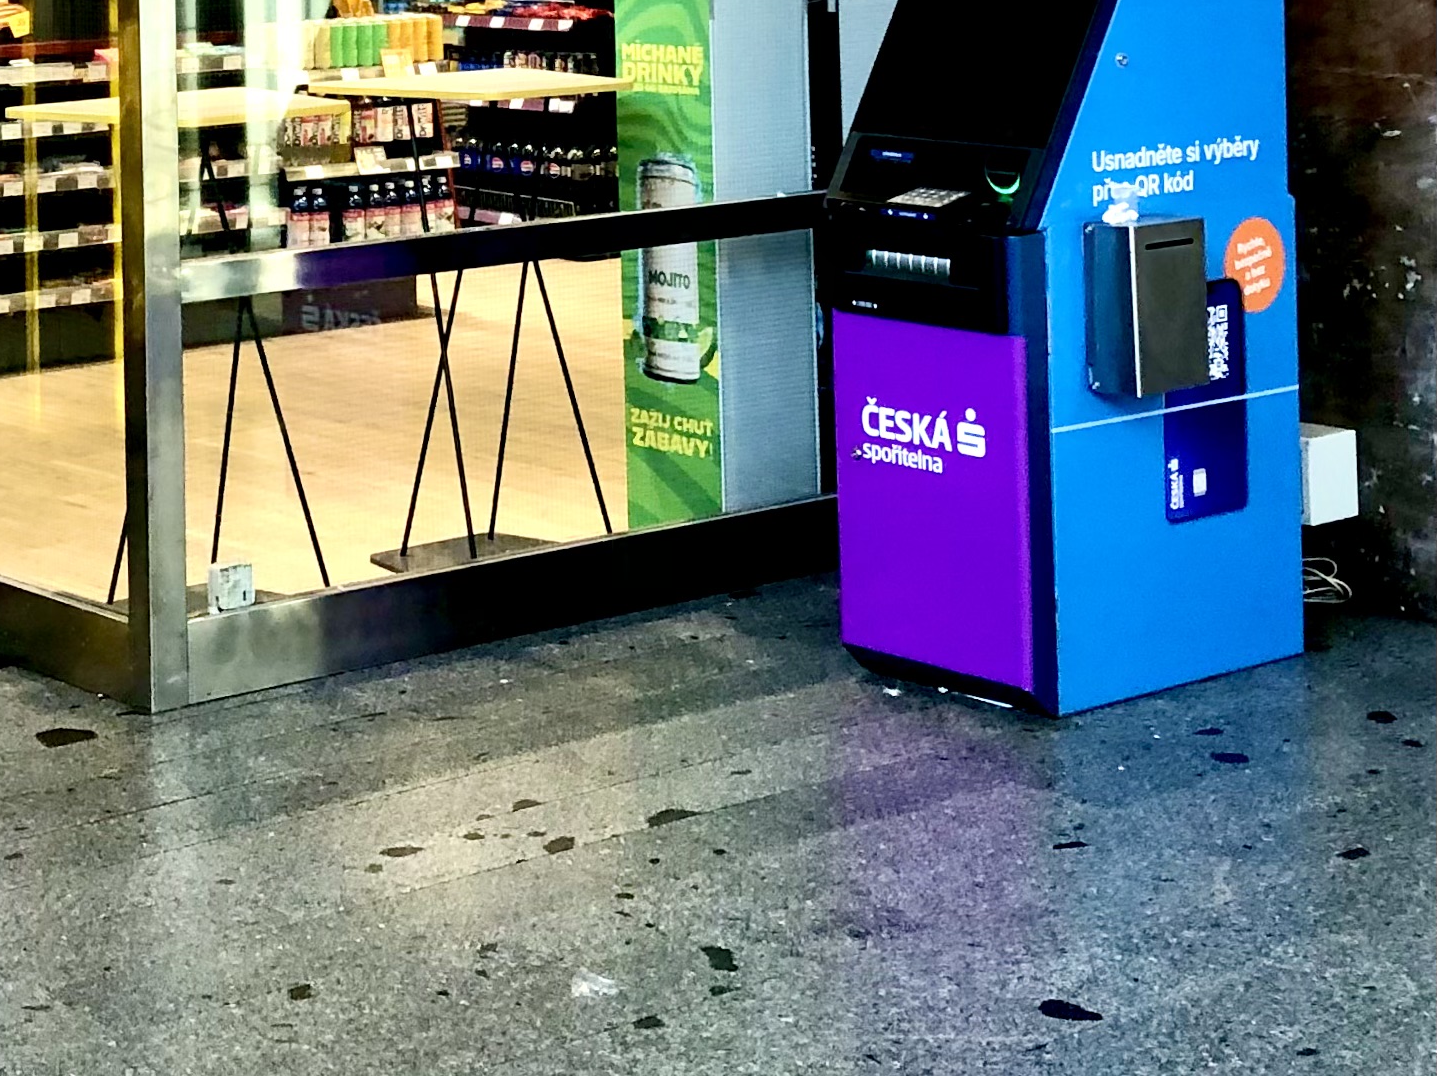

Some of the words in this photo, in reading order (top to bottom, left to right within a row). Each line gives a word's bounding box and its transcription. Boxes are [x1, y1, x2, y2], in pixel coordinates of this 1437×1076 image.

[622, 40, 703, 64] MÍCHANÉ
[622, 61, 703, 86] DRINKY
[1091, 143, 1183, 172] Usnadněte
[1186, 140, 1200, 163] si
[1203, 135, 1260, 165] výběry
[1092, 177, 1131, 207] př
[1134, 174, 1160, 197] QR
[1163, 170, 1194, 193] kód
[648, 269, 690, 289] MOJITO
[862, 396, 952, 452] ČESKÁ
[863, 443, 943, 473] spořitelna
